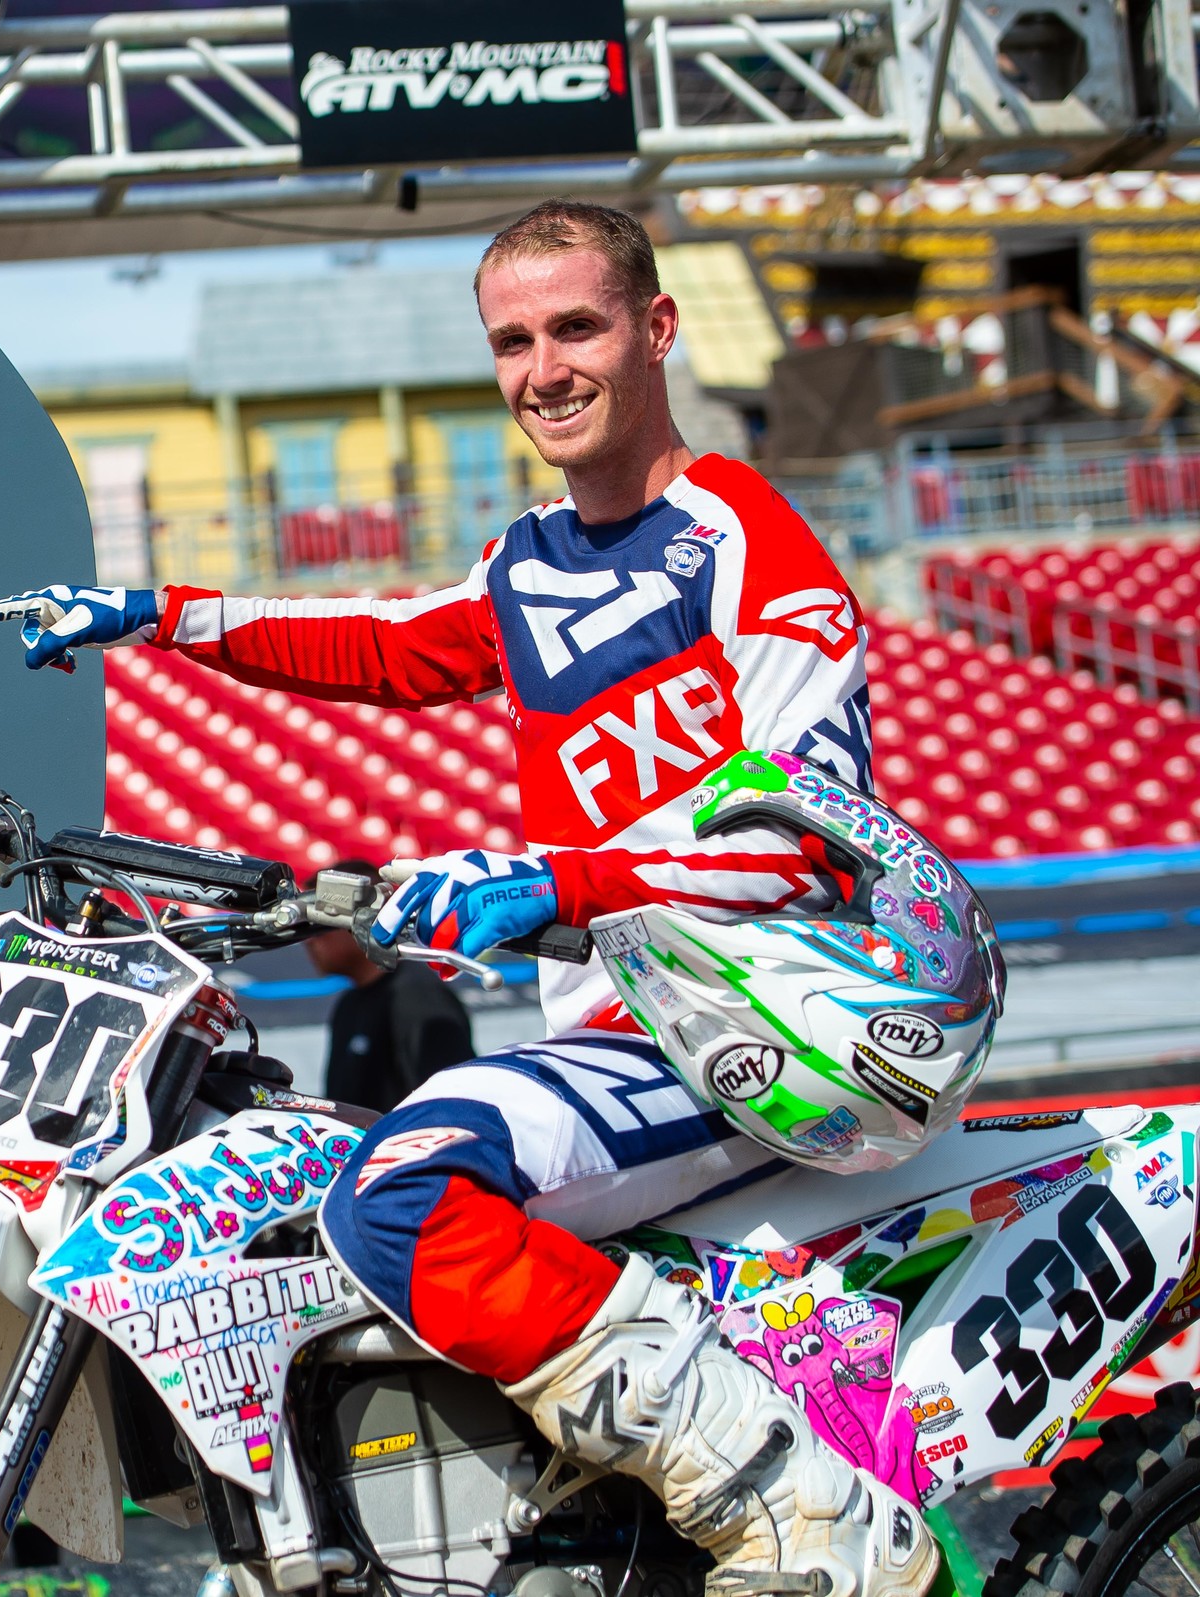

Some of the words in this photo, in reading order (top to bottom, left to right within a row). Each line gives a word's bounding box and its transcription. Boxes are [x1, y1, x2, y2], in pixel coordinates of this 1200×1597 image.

[348, 46, 449, 74] ROCKY
[450, 39, 608, 71] MOUNTAIN
[557, 666, 727, 830] FXR
[23, 936, 121, 972] MONSTER
[28, 957, 99, 978] ENERGY
[873, 1020, 941, 1054] Arai
[715, 1046, 772, 1099] Arai
[1134, 1151, 1174, 1189] AMA
[1021, 1166, 1092, 1210] CATANZARO
[84, 1281, 118, 1318] All
[299, 1303, 349, 1327] Kawasaki
[825, 1300, 868, 1325] MOTO
[951, 1183, 1157, 1440] 330
[834, 1308, 874, 1333] TAPE
[854, 1329, 881, 1345] BOLT
[31, 1340, 66, 1411] VALVES
[909, 1395, 955, 1424] BBQ
[915, 1434, 969, 1468] ESCO
